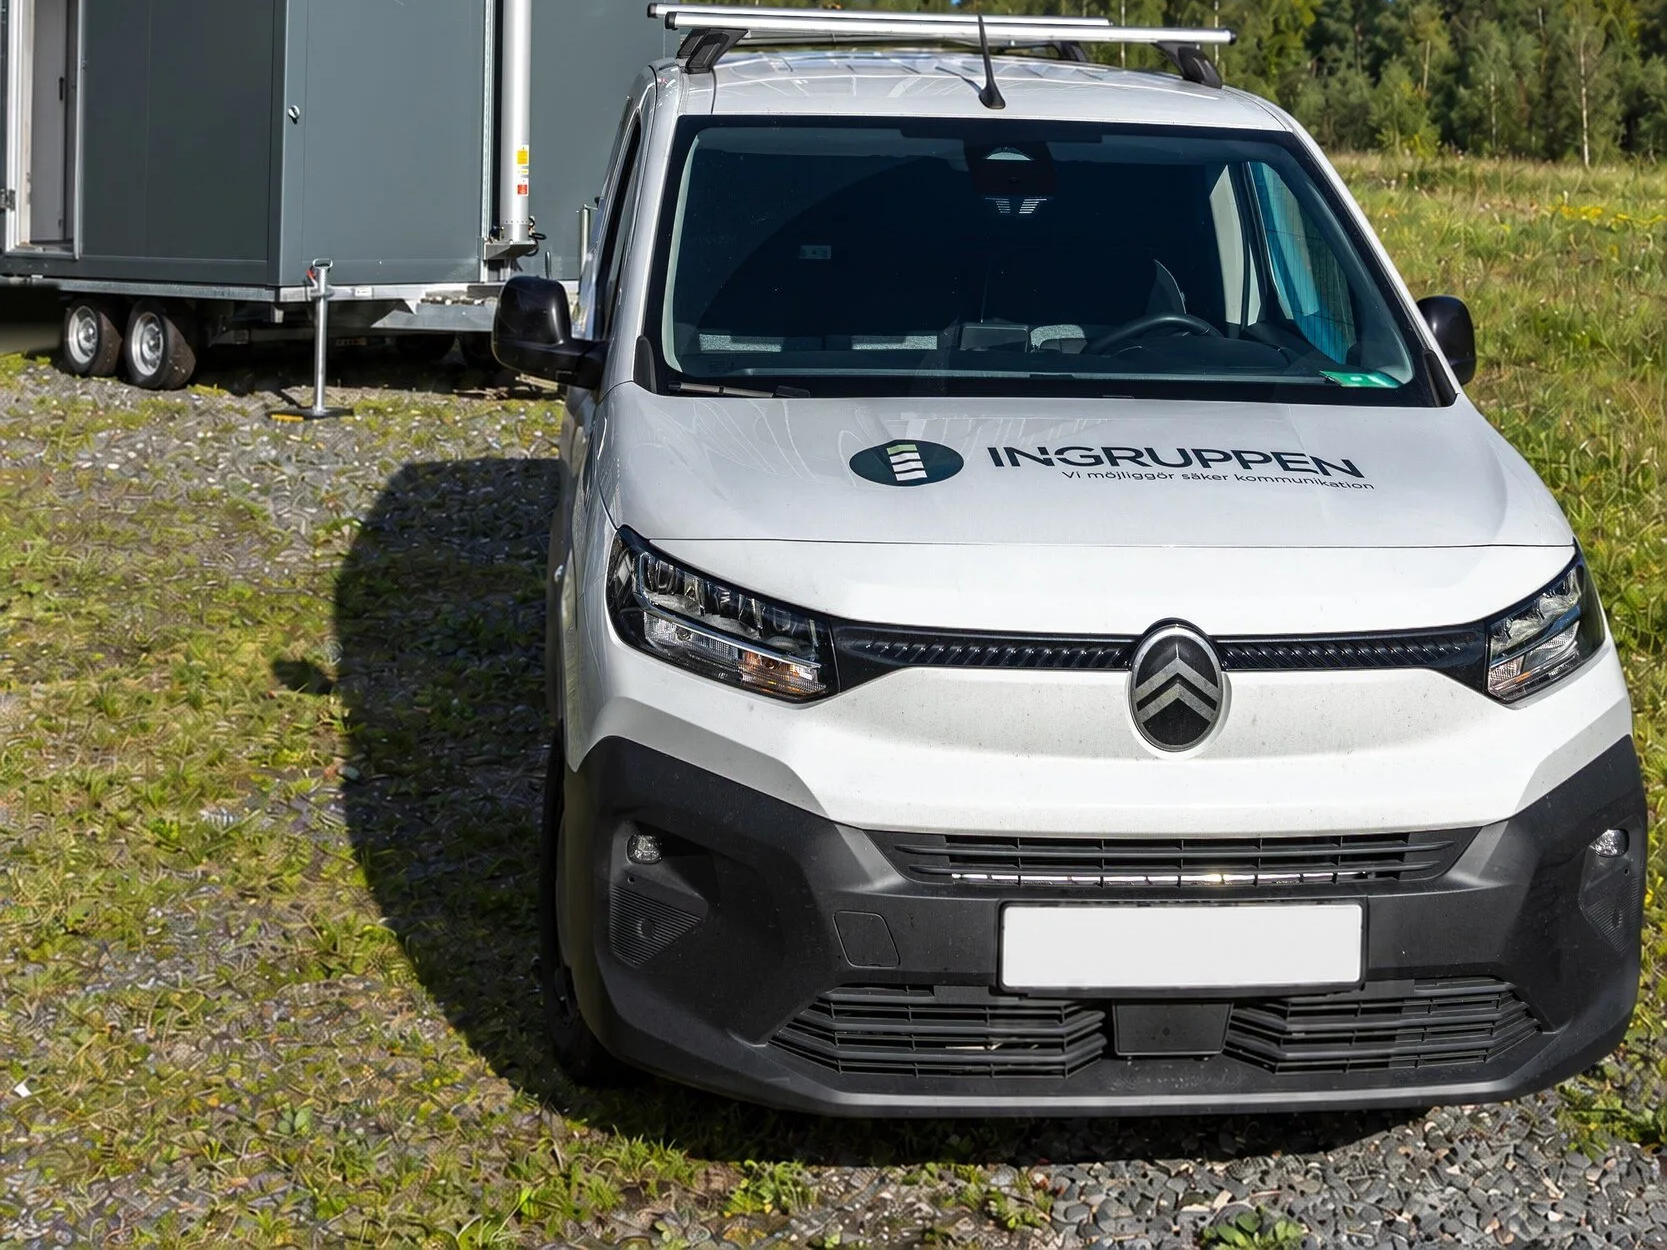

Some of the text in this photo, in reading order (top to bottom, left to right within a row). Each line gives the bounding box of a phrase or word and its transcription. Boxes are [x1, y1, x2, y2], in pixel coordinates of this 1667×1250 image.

[987, 446, 1365, 478] INGRUPPEN
[1061, 471, 1375, 490] Vi möjliggör säker kommunikation
